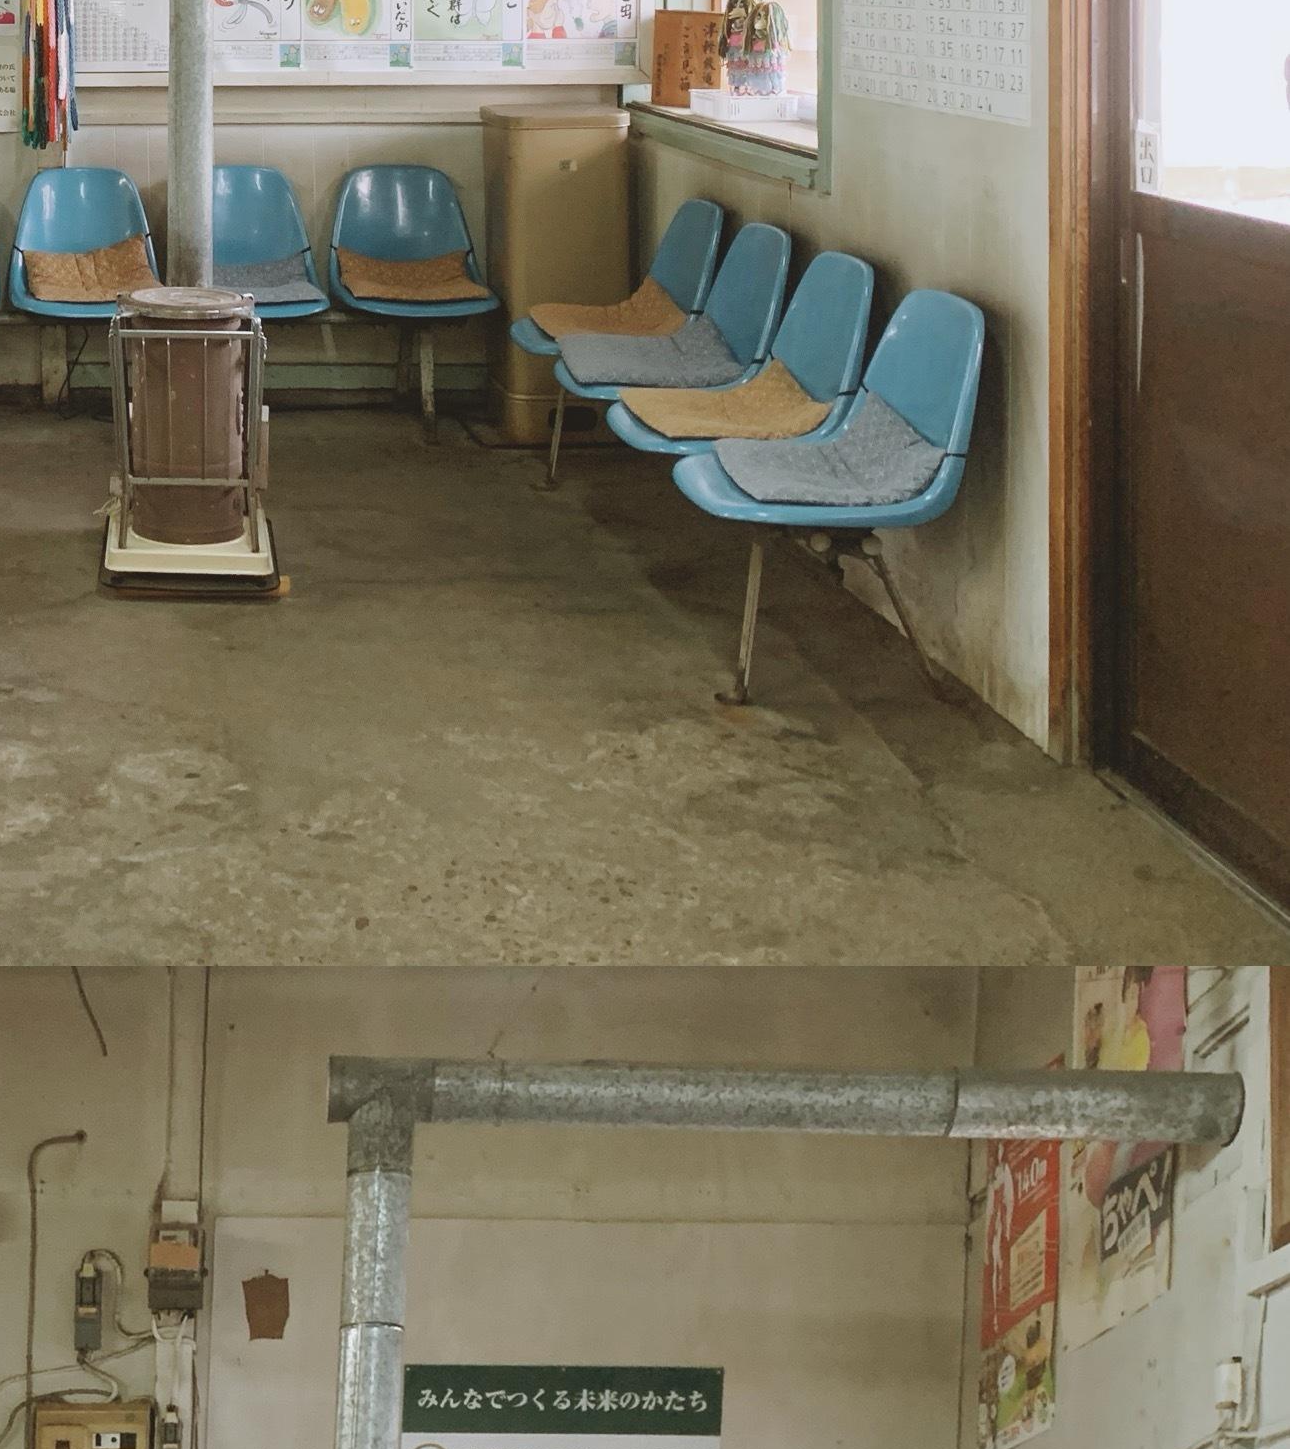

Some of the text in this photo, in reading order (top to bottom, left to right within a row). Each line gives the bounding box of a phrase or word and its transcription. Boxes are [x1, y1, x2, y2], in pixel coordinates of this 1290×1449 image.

[417, 1388, 708, 1412] みんなでつくる未来のかたち
